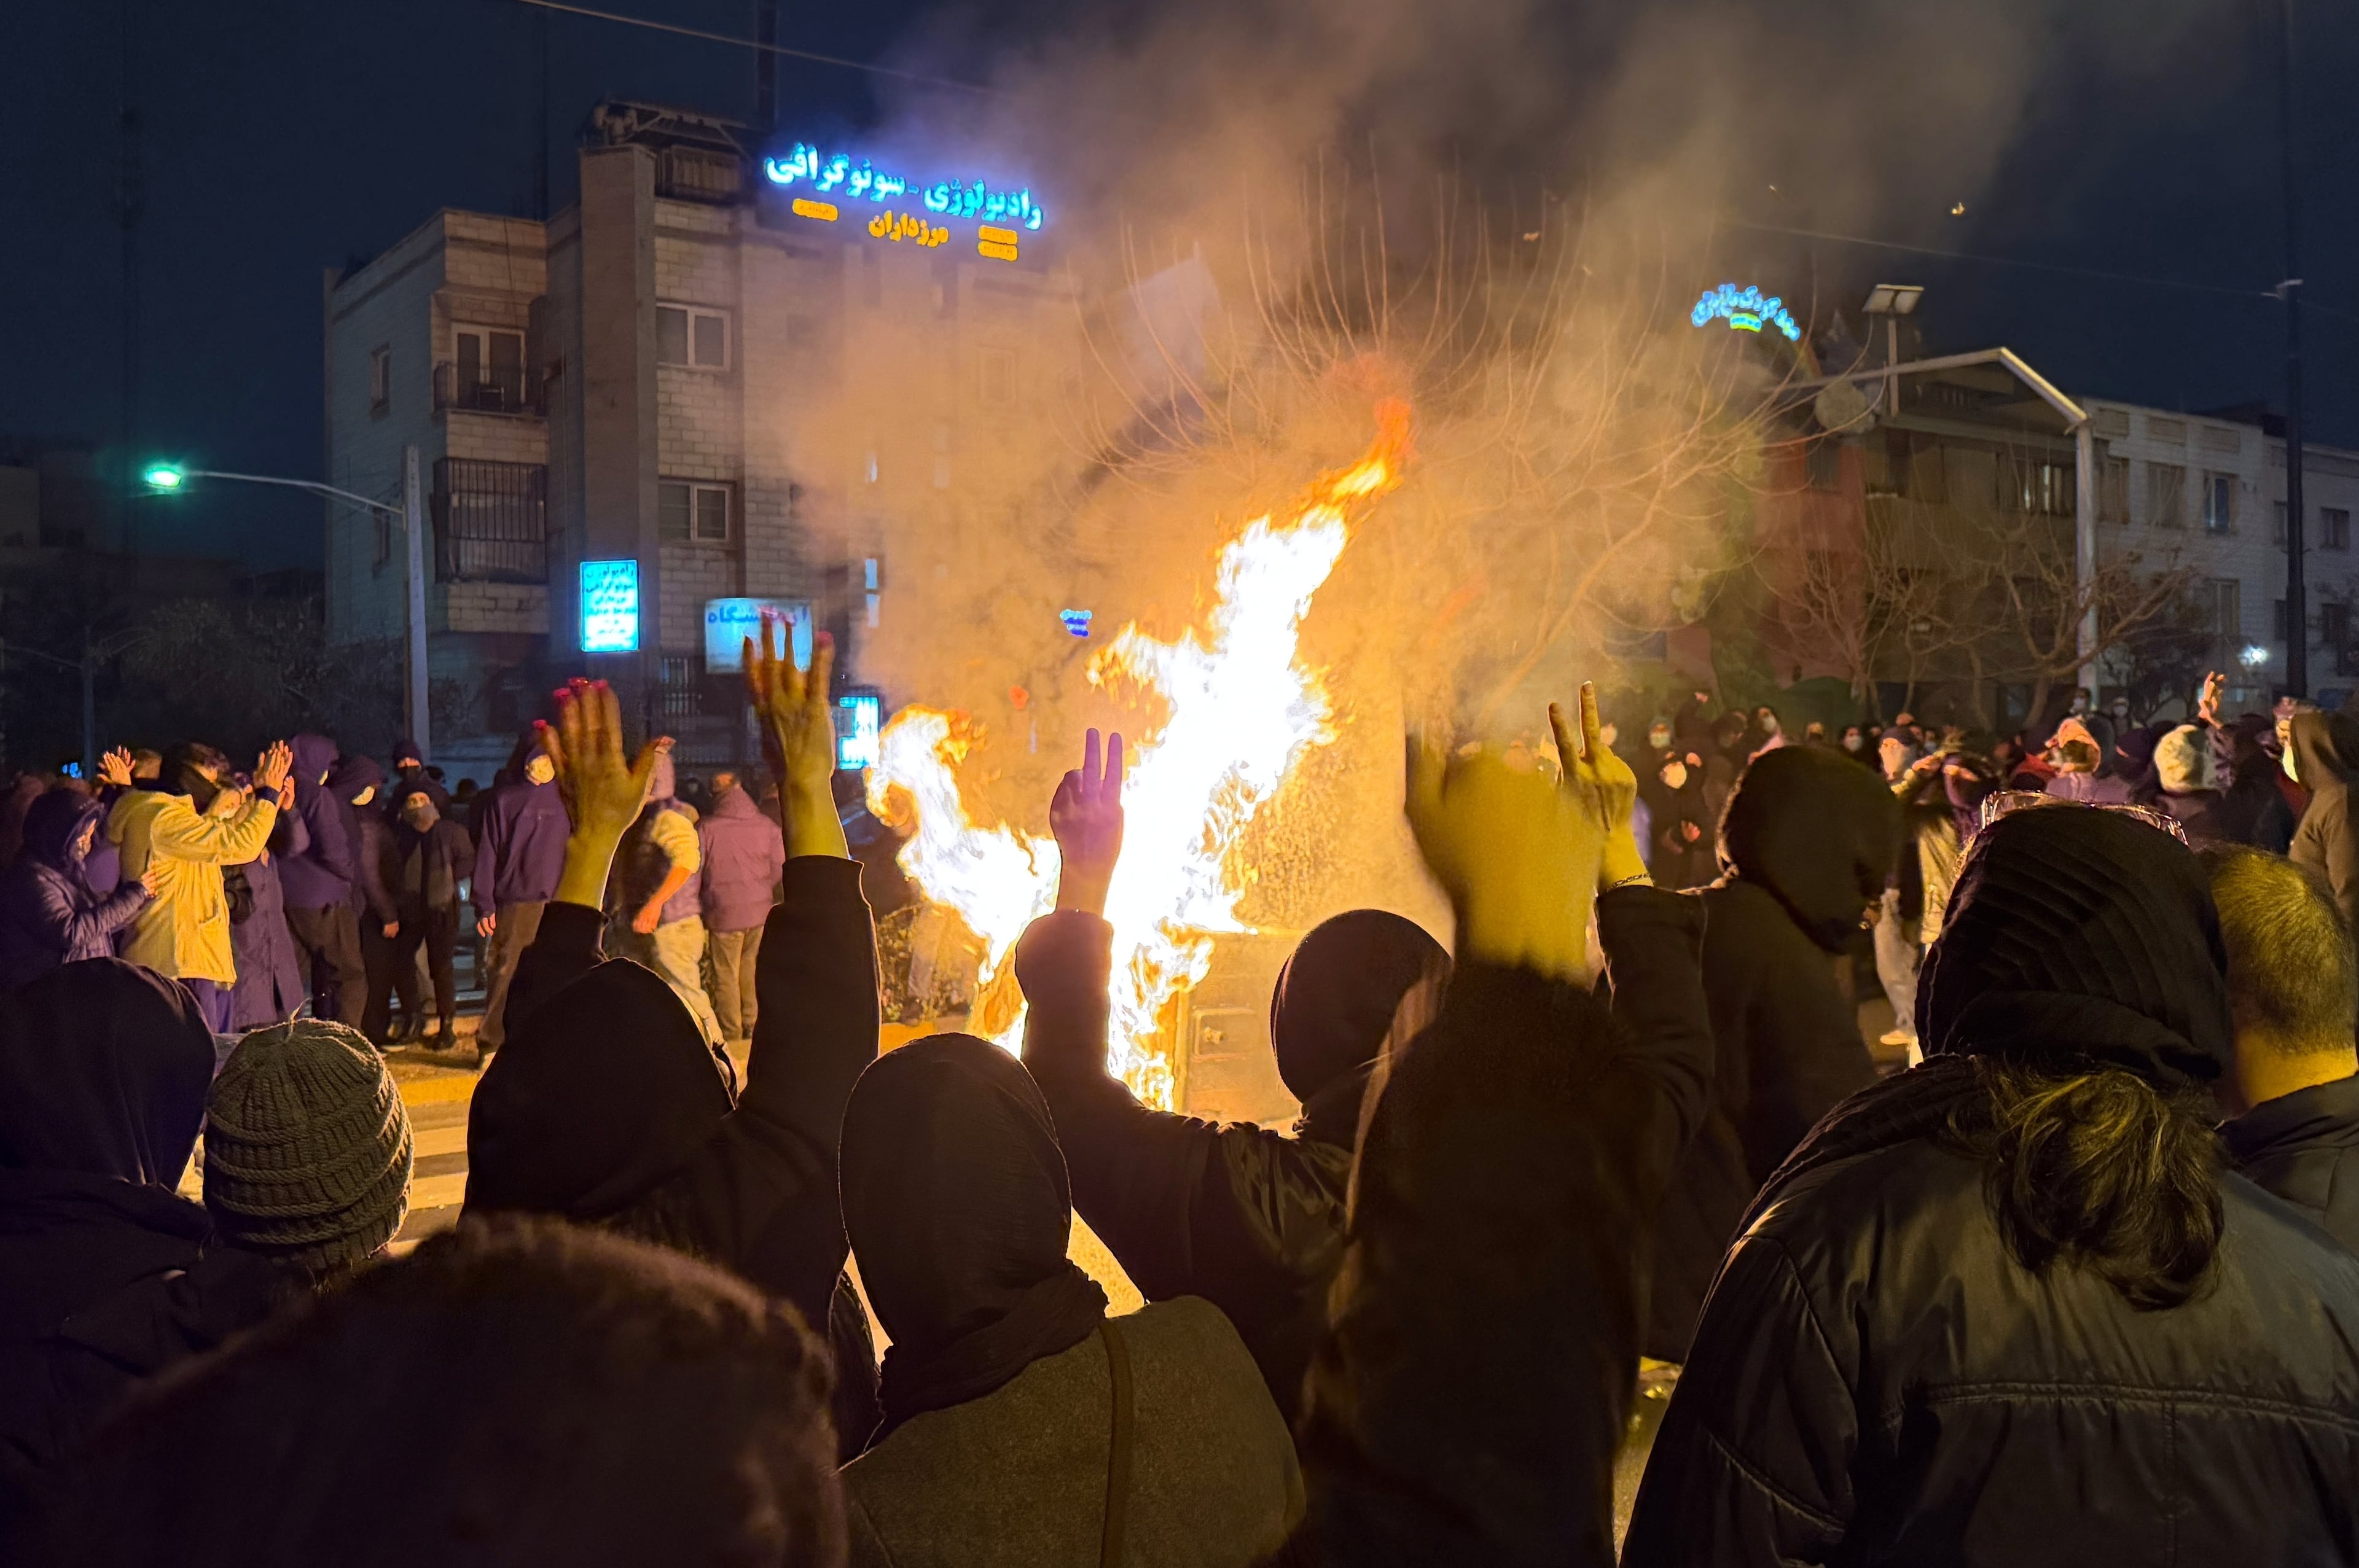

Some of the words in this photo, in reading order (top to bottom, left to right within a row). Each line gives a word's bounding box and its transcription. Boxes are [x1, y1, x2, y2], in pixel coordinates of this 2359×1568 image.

[765, 142, 906, 202] سونوگرافی
[868, 210, 949, 248] مرزداران
[923, 178, 1043, 230] رادیولوژی
